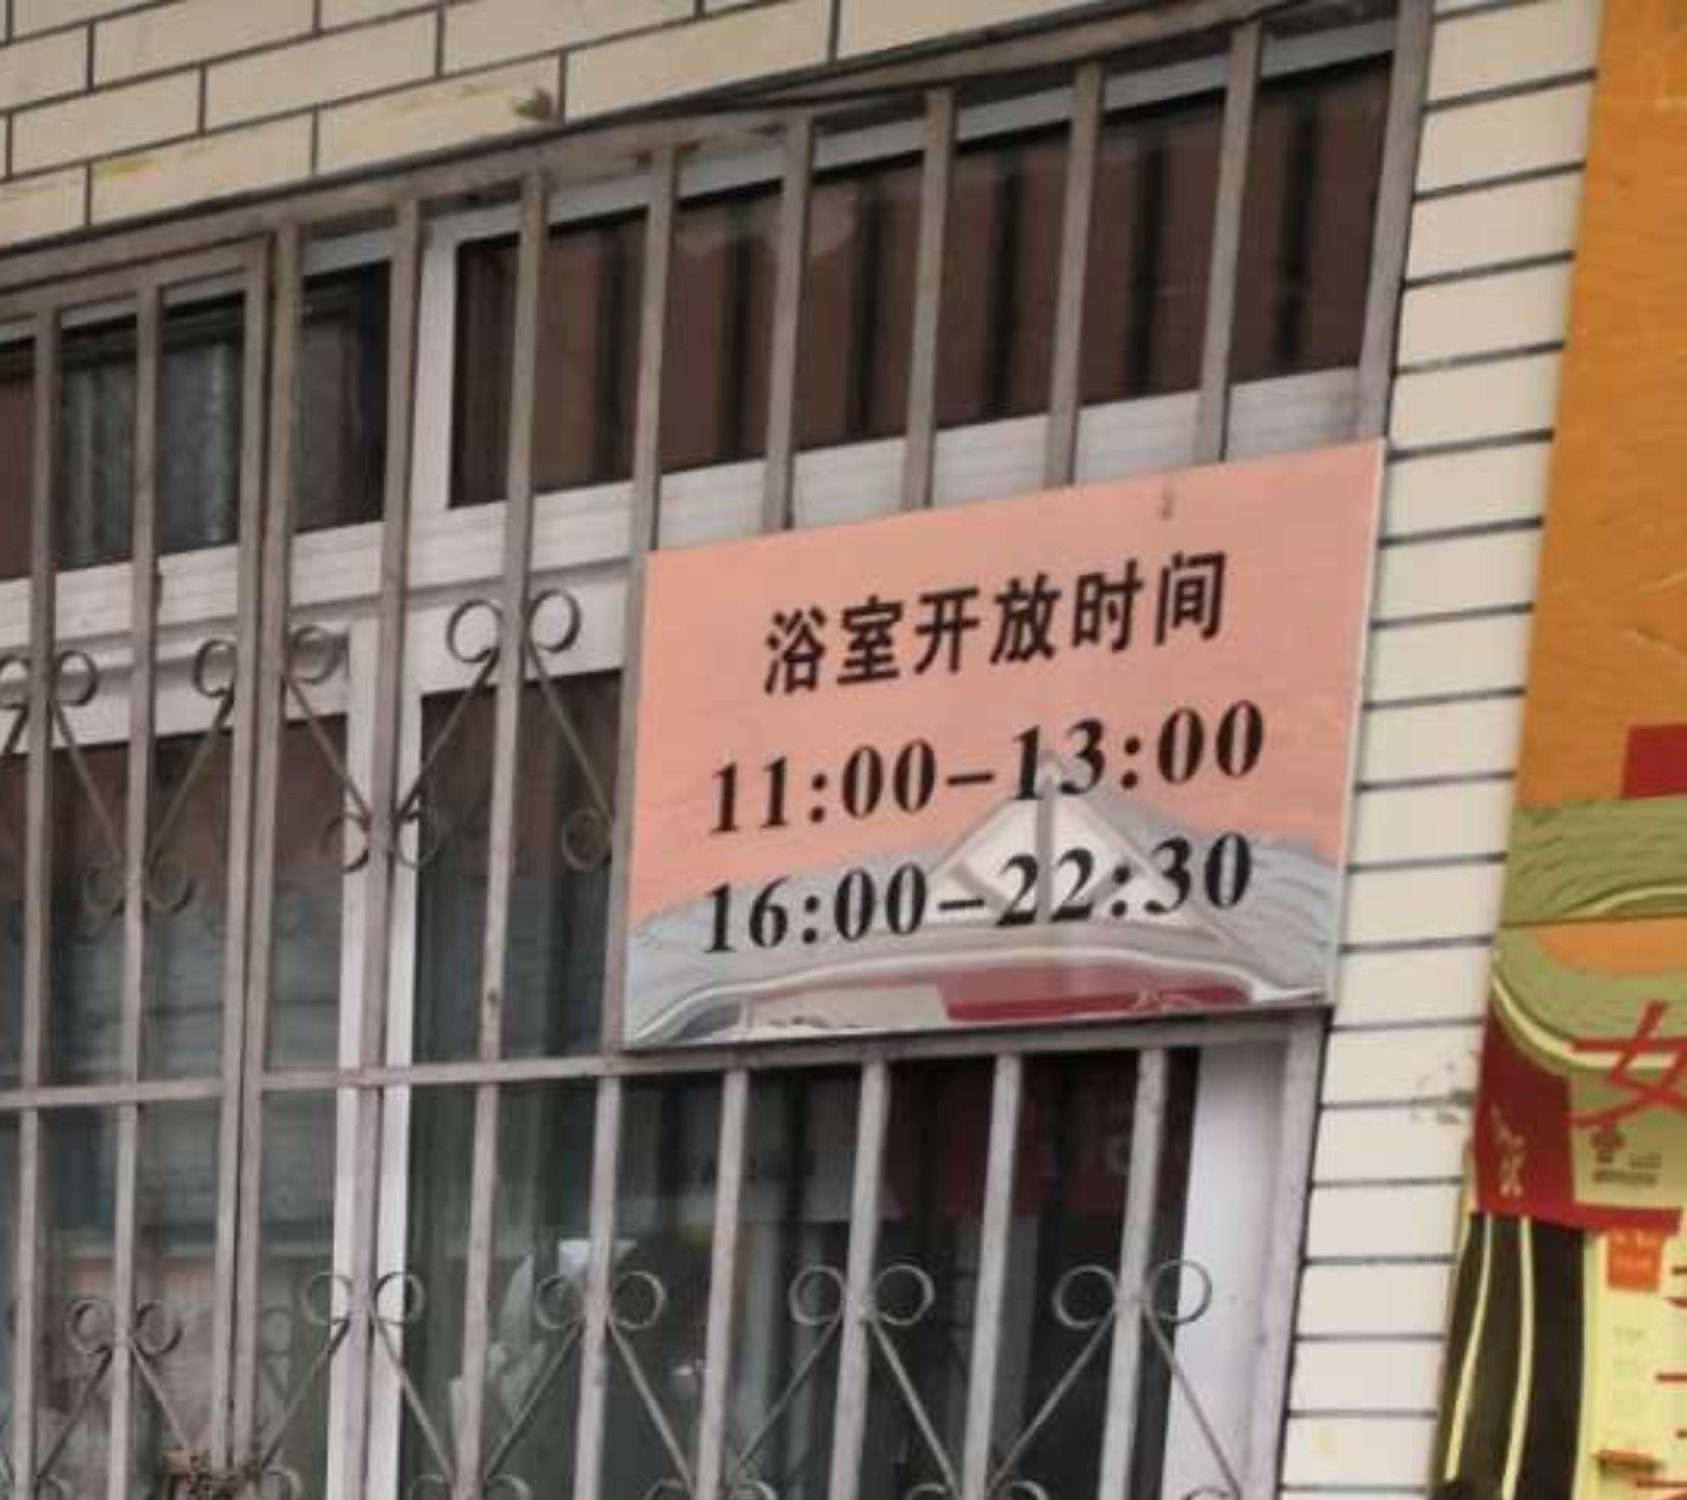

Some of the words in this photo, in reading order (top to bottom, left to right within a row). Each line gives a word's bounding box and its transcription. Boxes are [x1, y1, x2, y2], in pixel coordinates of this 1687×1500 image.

[763, 551, 1229, 695] 浴室开放时间
[709, 699, 1267, 836] 11:00-13:00
[702, 832, 1254, 955] 16:00-22:30
